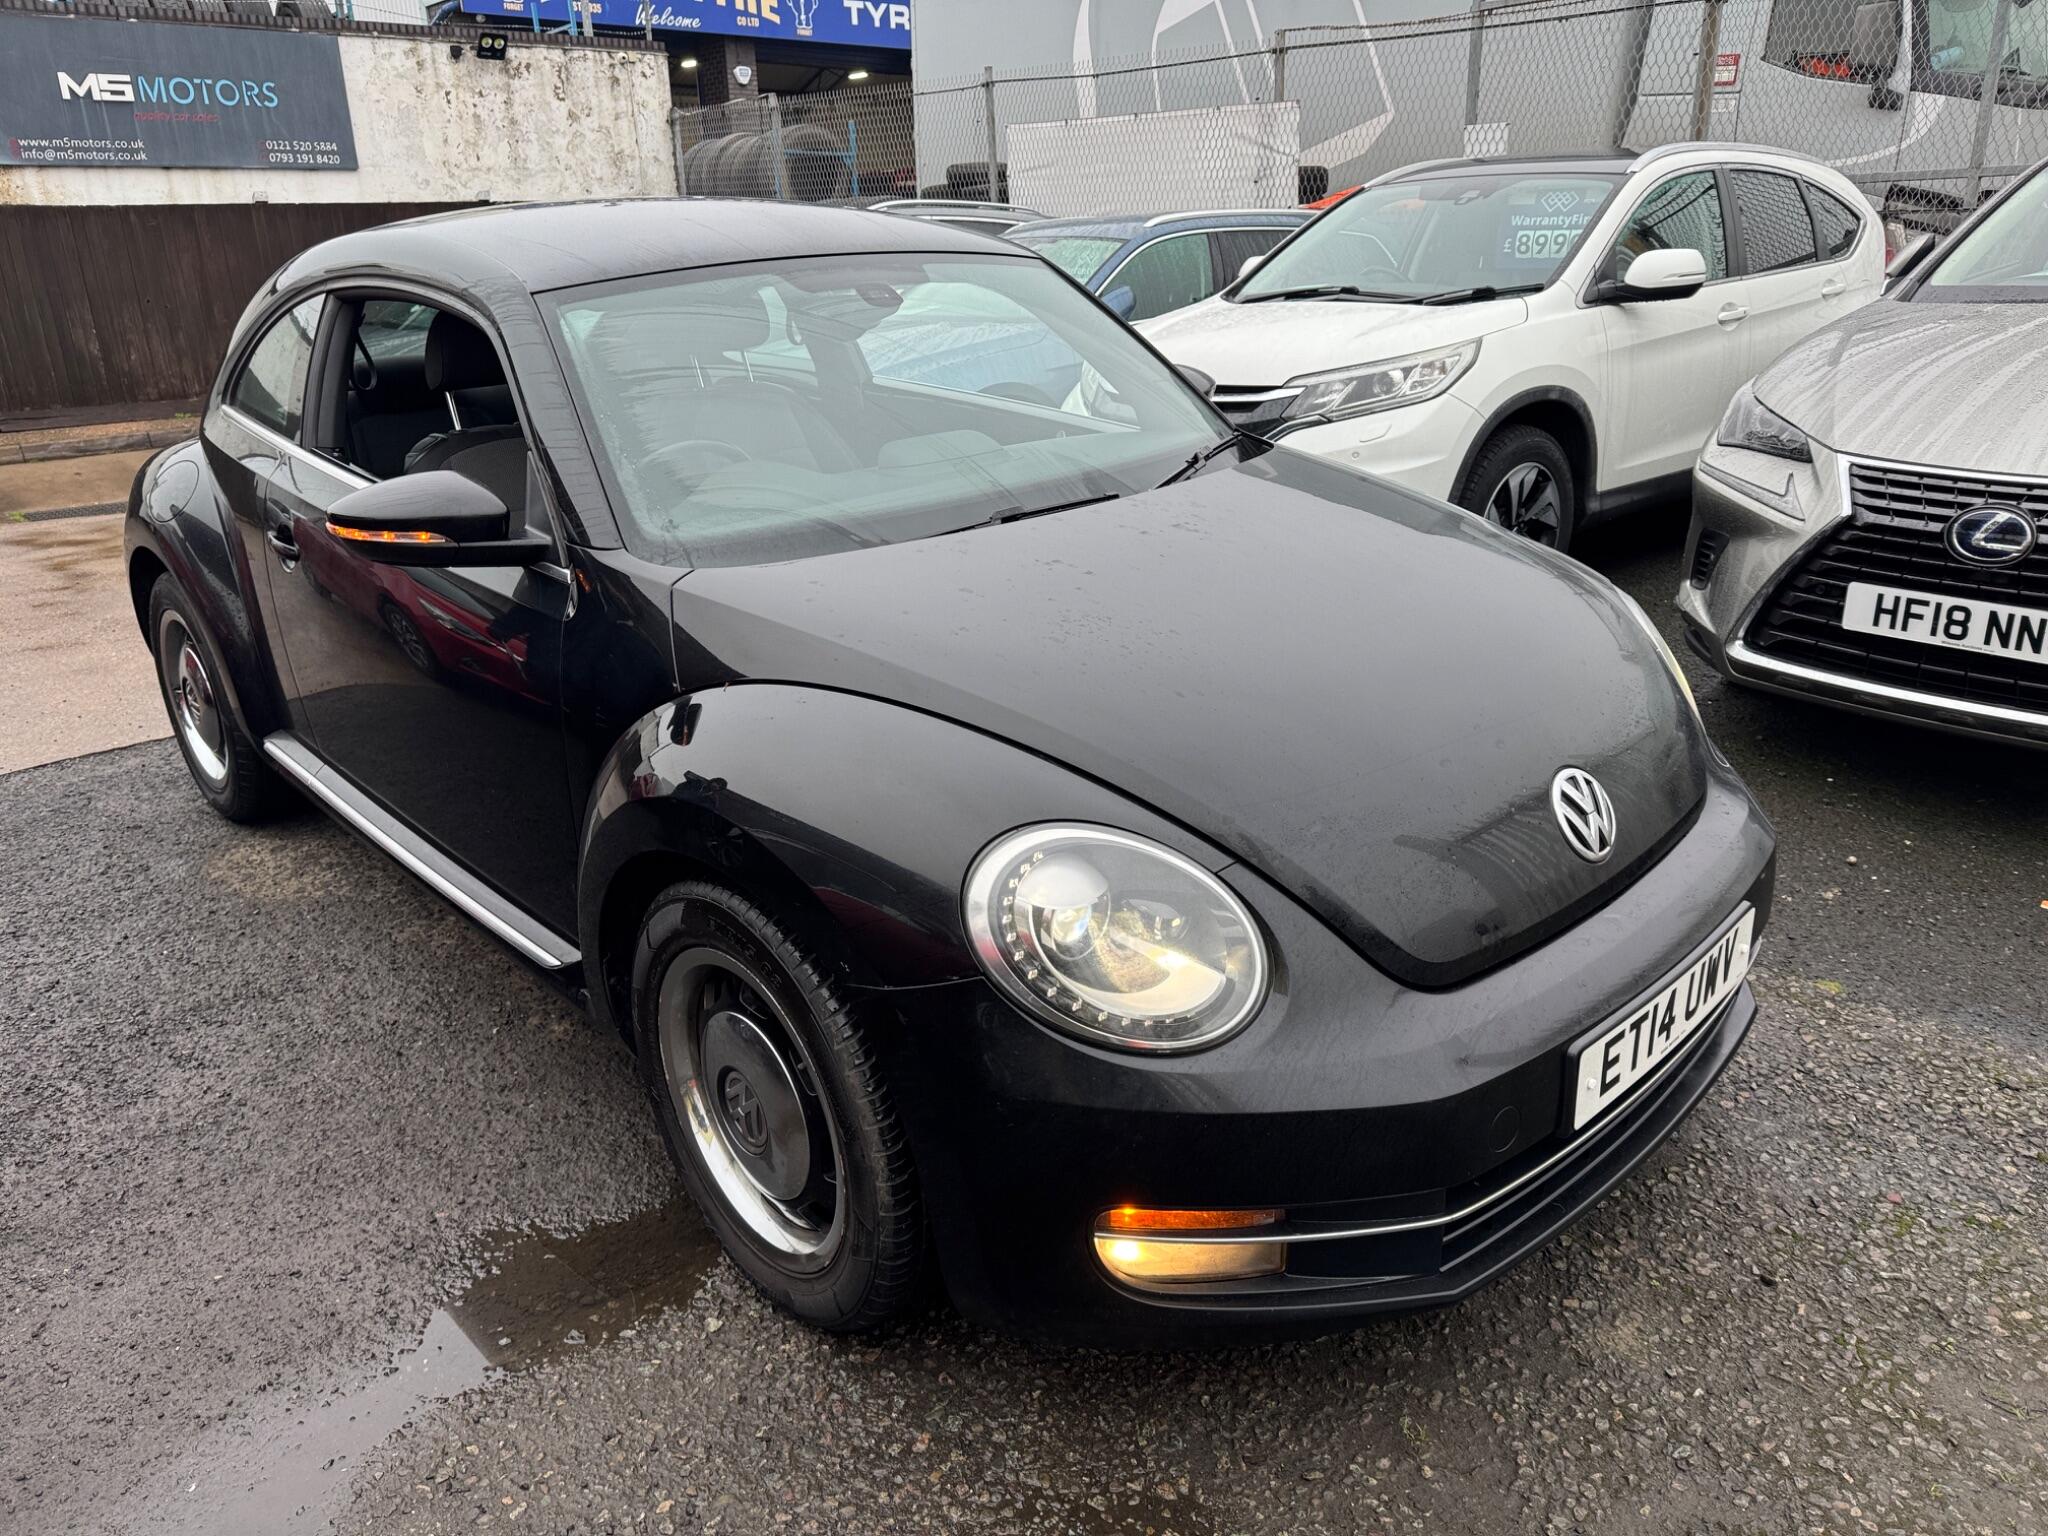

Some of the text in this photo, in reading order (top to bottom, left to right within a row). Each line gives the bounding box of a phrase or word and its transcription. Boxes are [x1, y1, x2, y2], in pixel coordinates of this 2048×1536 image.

[635, 4, 701, 28] Welcome
[737, 16, 760, 27] CO LTD
[57, 72, 278, 108] M5 MOTORS
[18, 137, 144, 149] www.m5motors.co.uk
[265, 140, 337, 151] 0121 520 5884
[21, 149, 148, 161] info@m5motors.co.uk
[269, 152, 340, 165] 0793 191 8420
[1872, 593, 2048, 655] HF18 NN
[1600, 926, 1740, 1098] ET14 UWV
